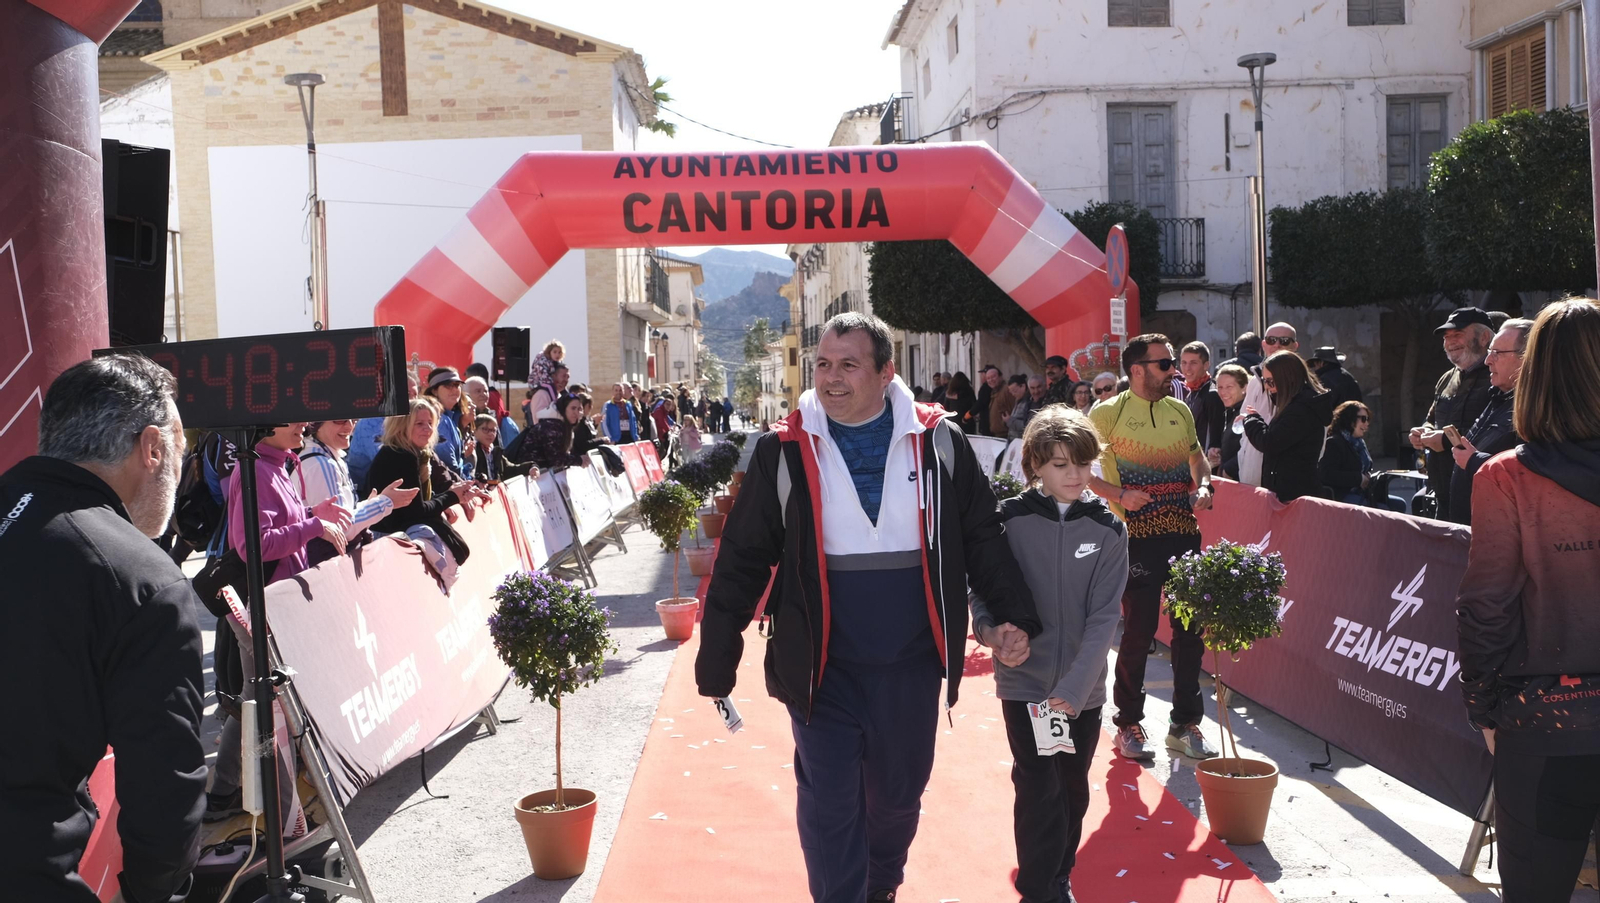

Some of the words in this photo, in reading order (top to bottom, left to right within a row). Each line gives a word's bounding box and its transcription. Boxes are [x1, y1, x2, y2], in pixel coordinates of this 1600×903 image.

[613, 150, 899, 179] AYUNTAMIENTO
[622, 187, 891, 234] CANTORIA
[1078, 543, 1097, 552] NIKE
[1553, 540, 1594, 553] VALLE
[1325, 616, 1461, 692] TEAMERGY
[339, 652, 422, 745] TEAMERGY
[1337, 677, 1407, 719] www.teamergy.es
